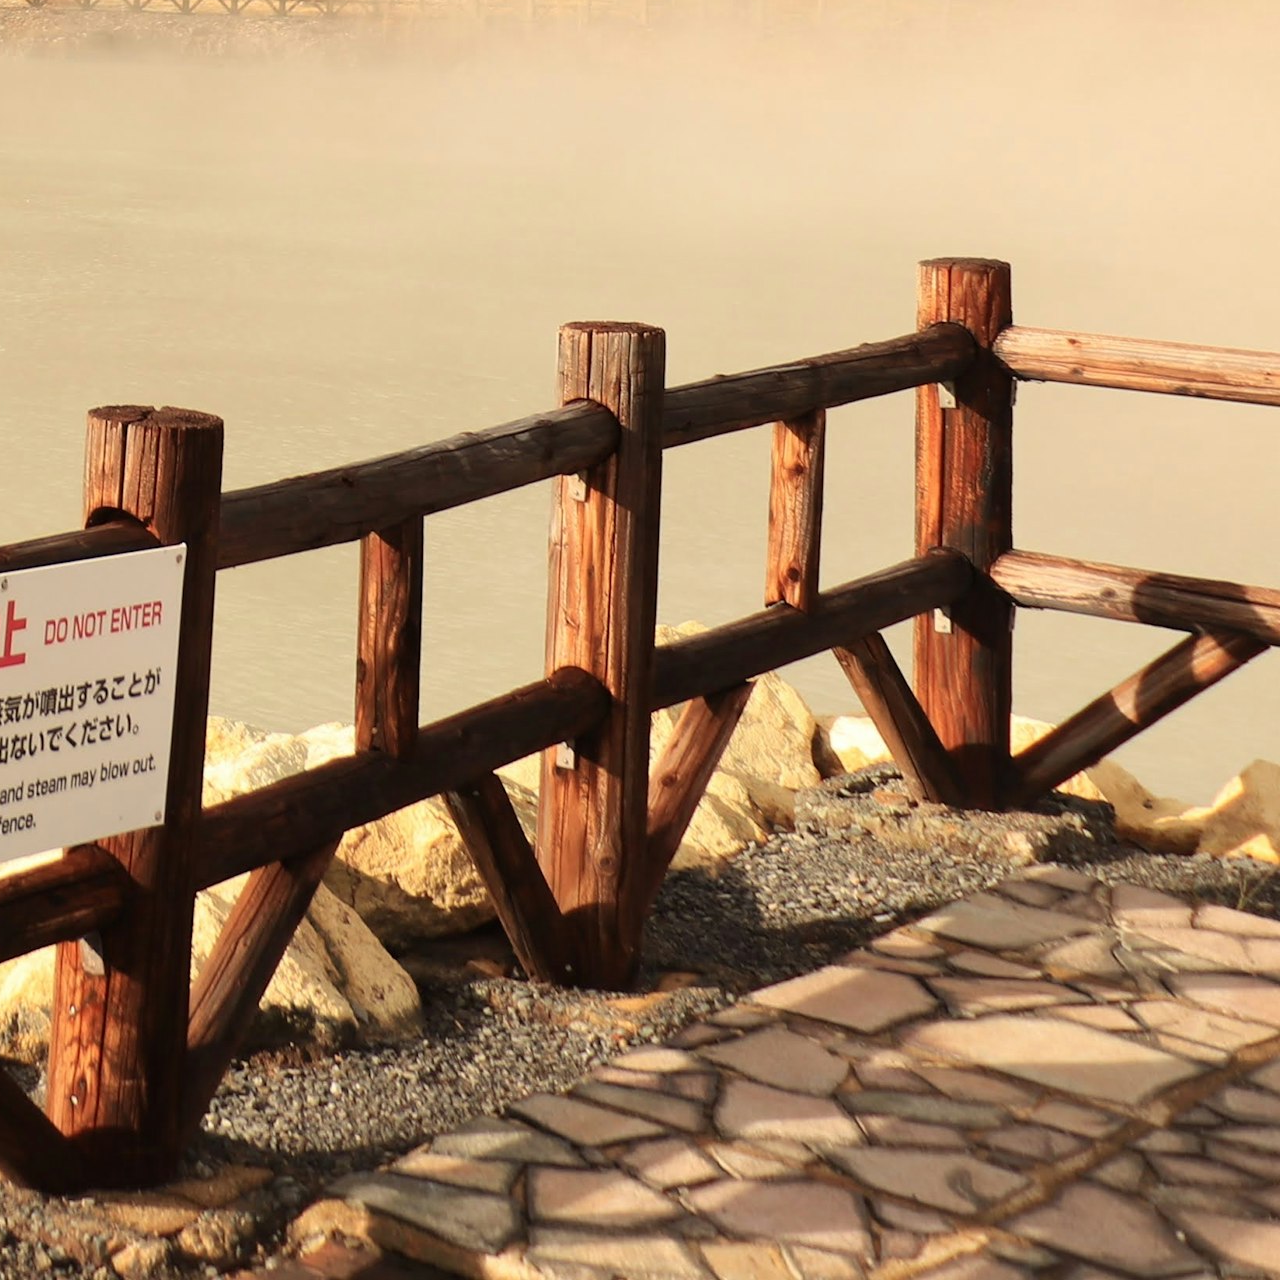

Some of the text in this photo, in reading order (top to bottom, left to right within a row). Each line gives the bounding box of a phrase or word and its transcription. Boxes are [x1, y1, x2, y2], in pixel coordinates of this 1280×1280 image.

[44, 600, 163, 646] DO NOT ENTER
[0, 780, 24, 806] and
[27, 776, 67, 799] steam
[70, 769, 97, 788] may
[100, 760, 130, 782] blow
[132, 753, 156, 774] out.
